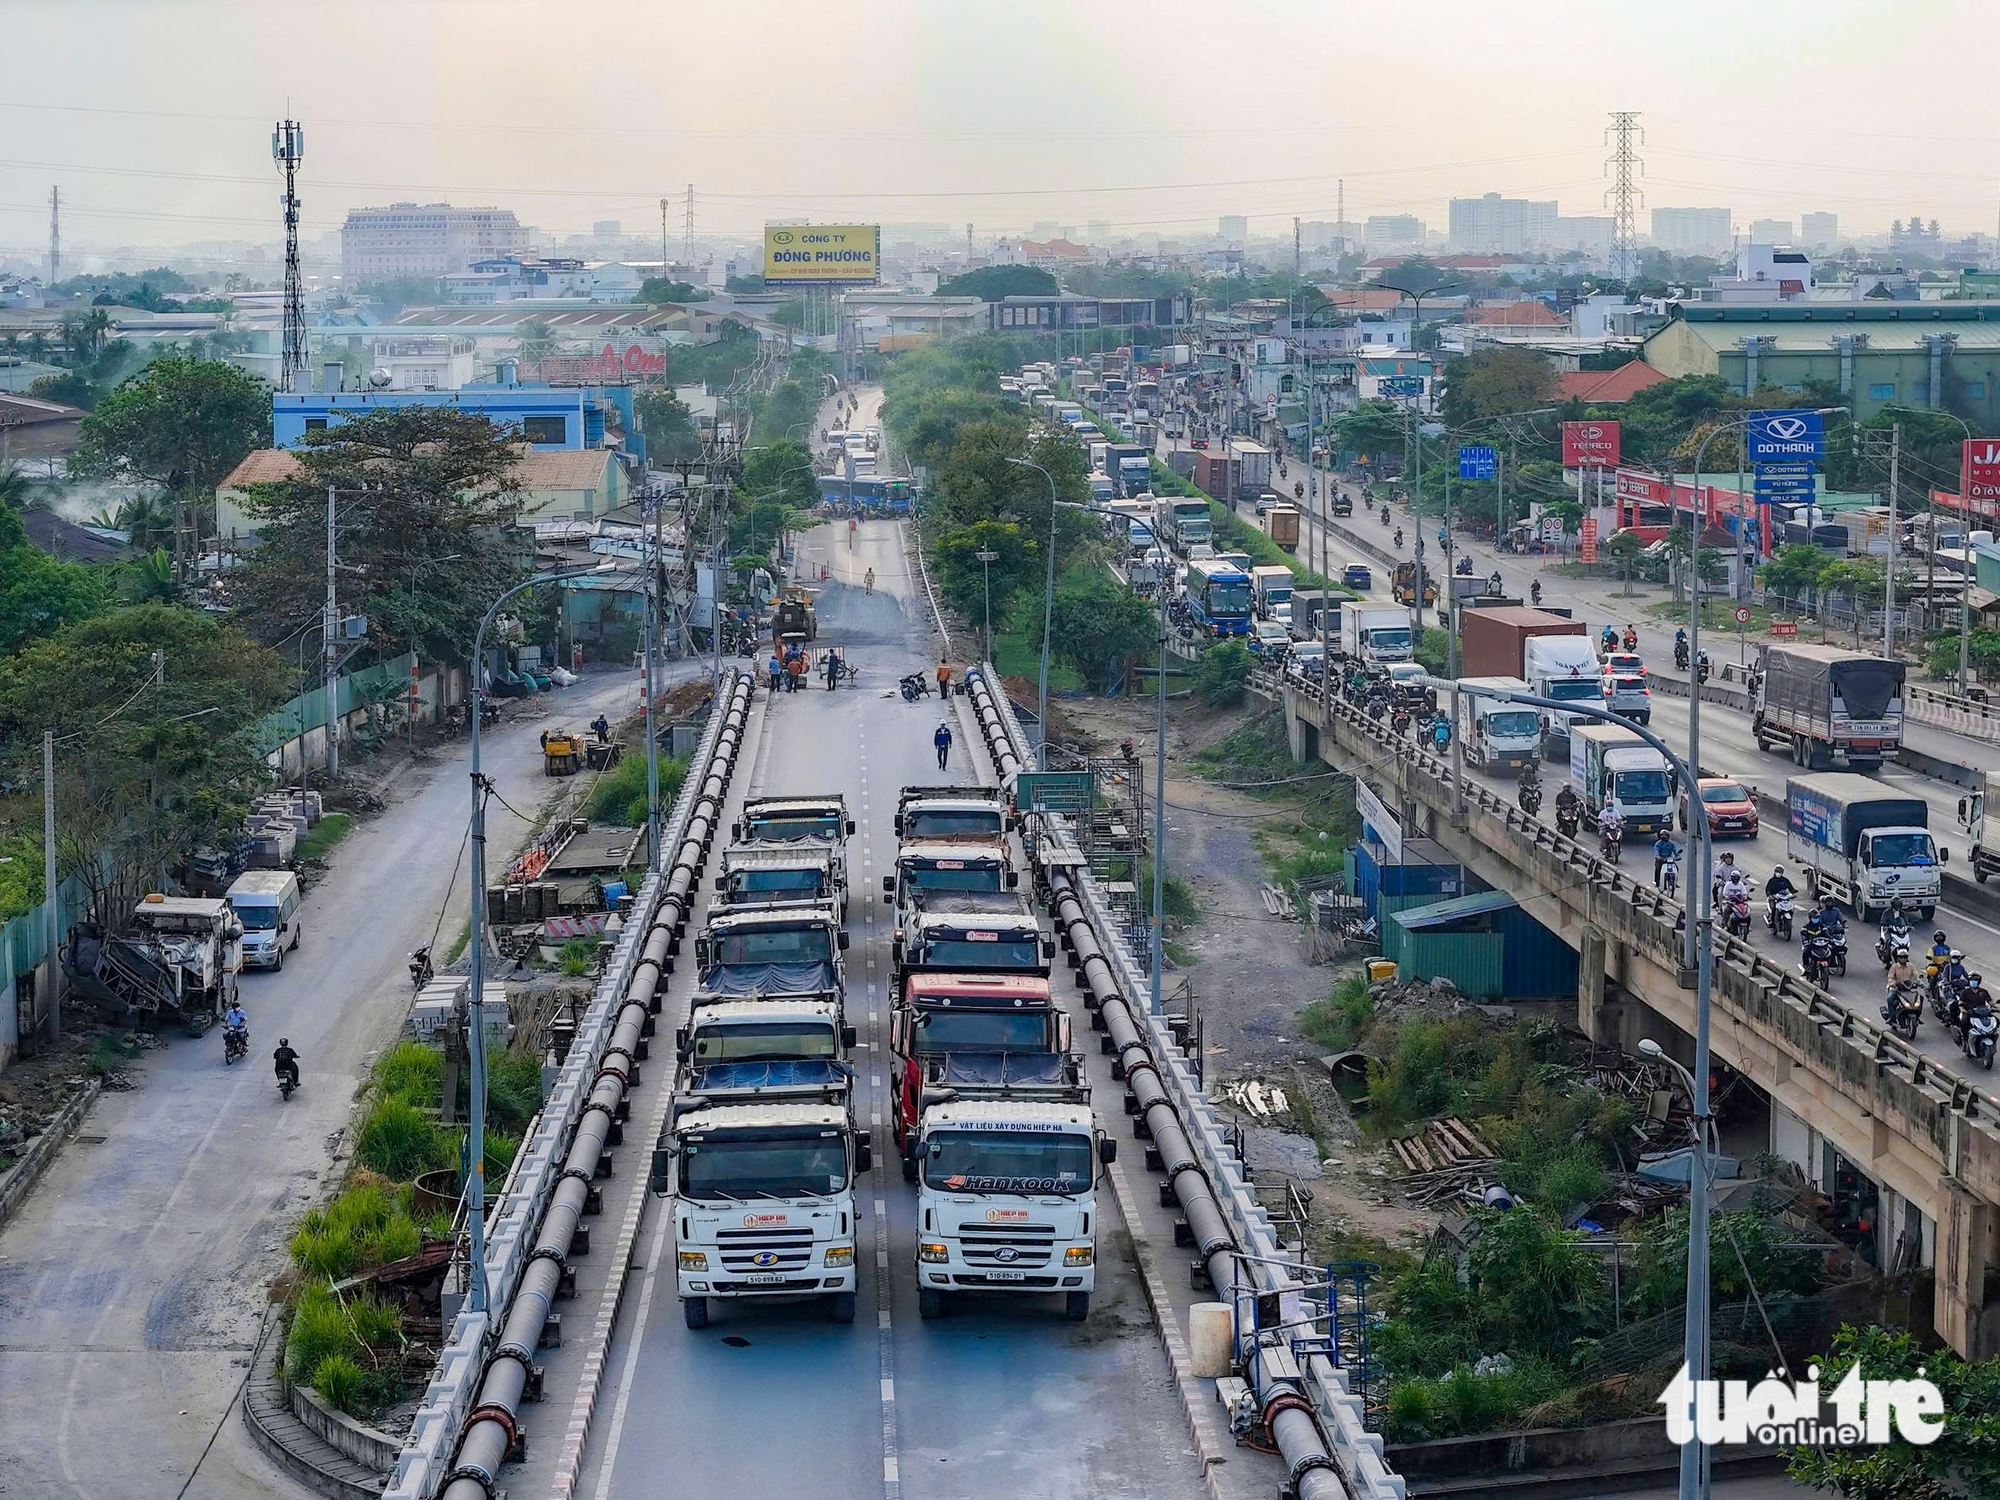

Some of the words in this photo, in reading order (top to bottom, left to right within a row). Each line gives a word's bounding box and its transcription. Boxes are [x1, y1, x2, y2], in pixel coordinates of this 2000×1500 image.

[773, 249, 811, 262] ĐÔNG
[815, 249, 871, 262] PHƯƠNG
[1758, 443, 1814, 453] DOTHANH
[976, 1121, 993, 1130] LIỆU
[995, 1122, 1010, 1130] XÂY
[1011, 1122, 1032, 1131] DỰNG
[1033, 1122, 1050, 1131] HIỆP
[1053, 1123, 1062, 1131] HÀ
